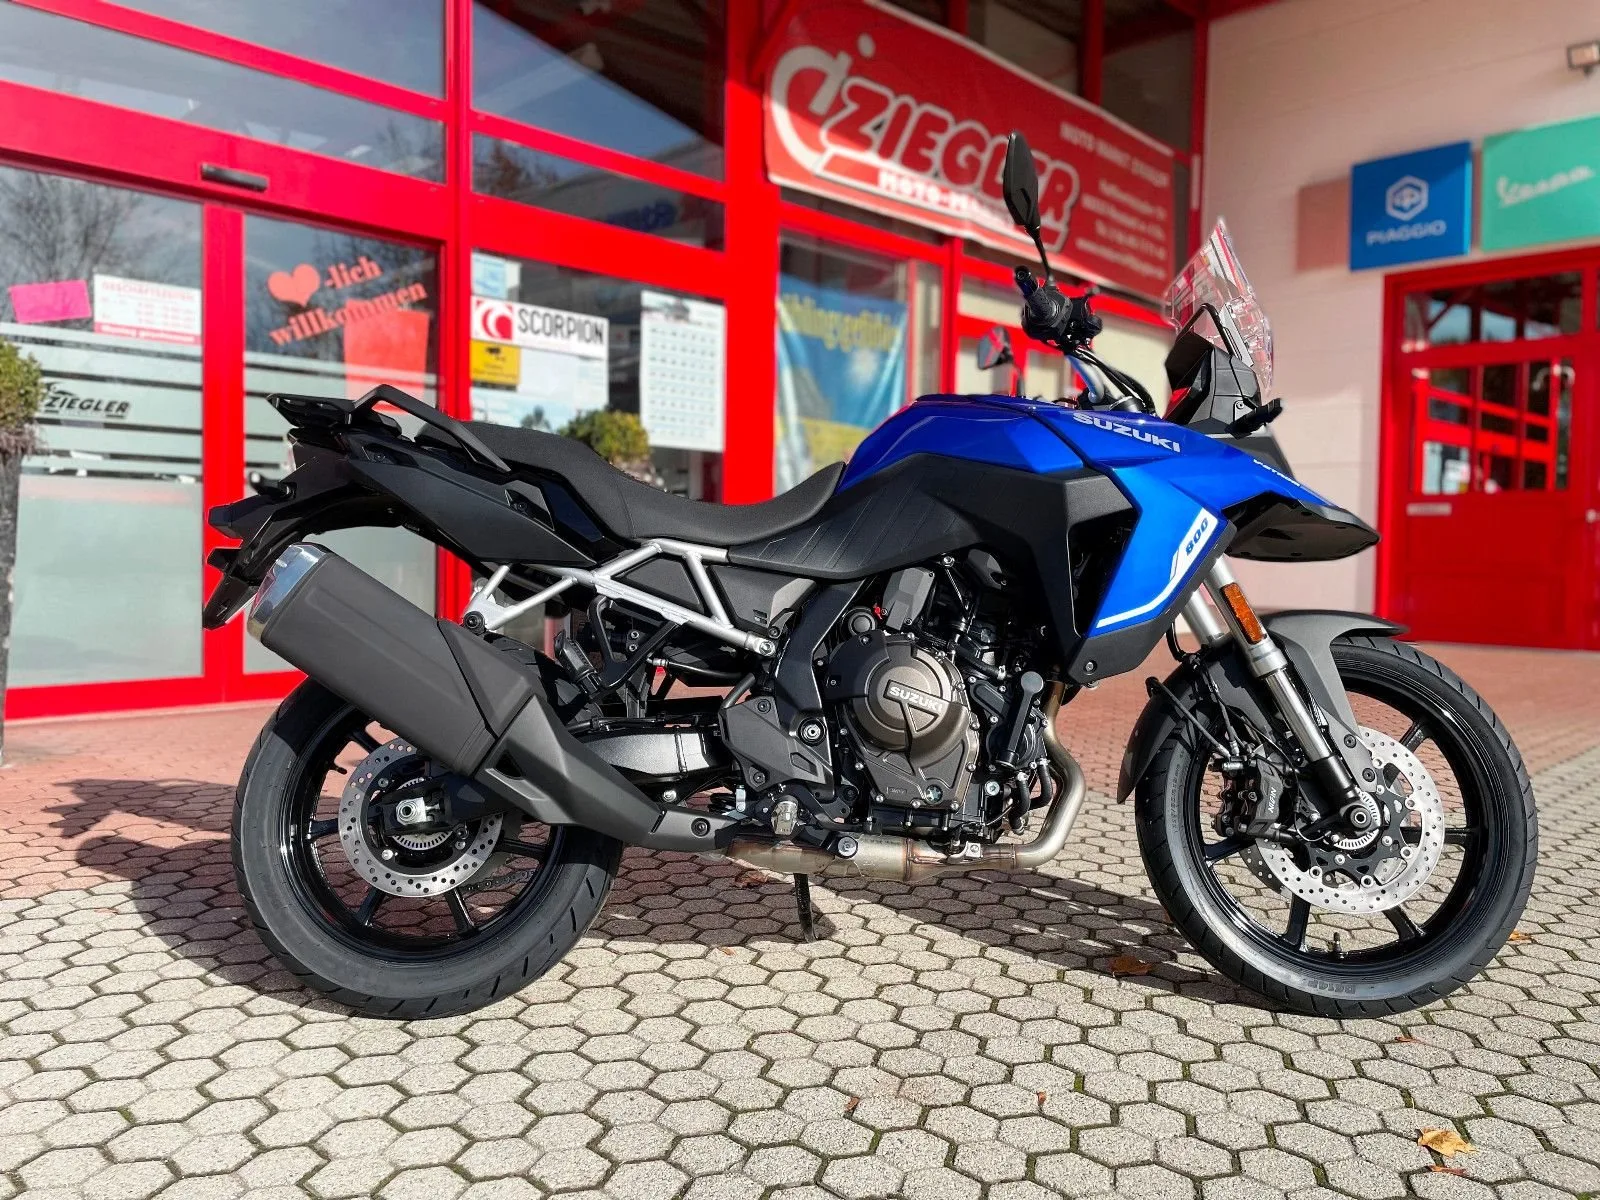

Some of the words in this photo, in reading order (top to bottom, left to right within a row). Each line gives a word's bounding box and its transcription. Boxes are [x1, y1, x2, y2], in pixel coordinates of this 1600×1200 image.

[269, 282, 428, 346] willkommen
[517, 308, 605, 345] SCORPION
[44, 396, 131, 413] ZIEGLER
[1073, 412, 1181, 453] SUZUKI
[1185, 517, 1209, 556] 800
[889, 686, 943, 712] SUZUKI
